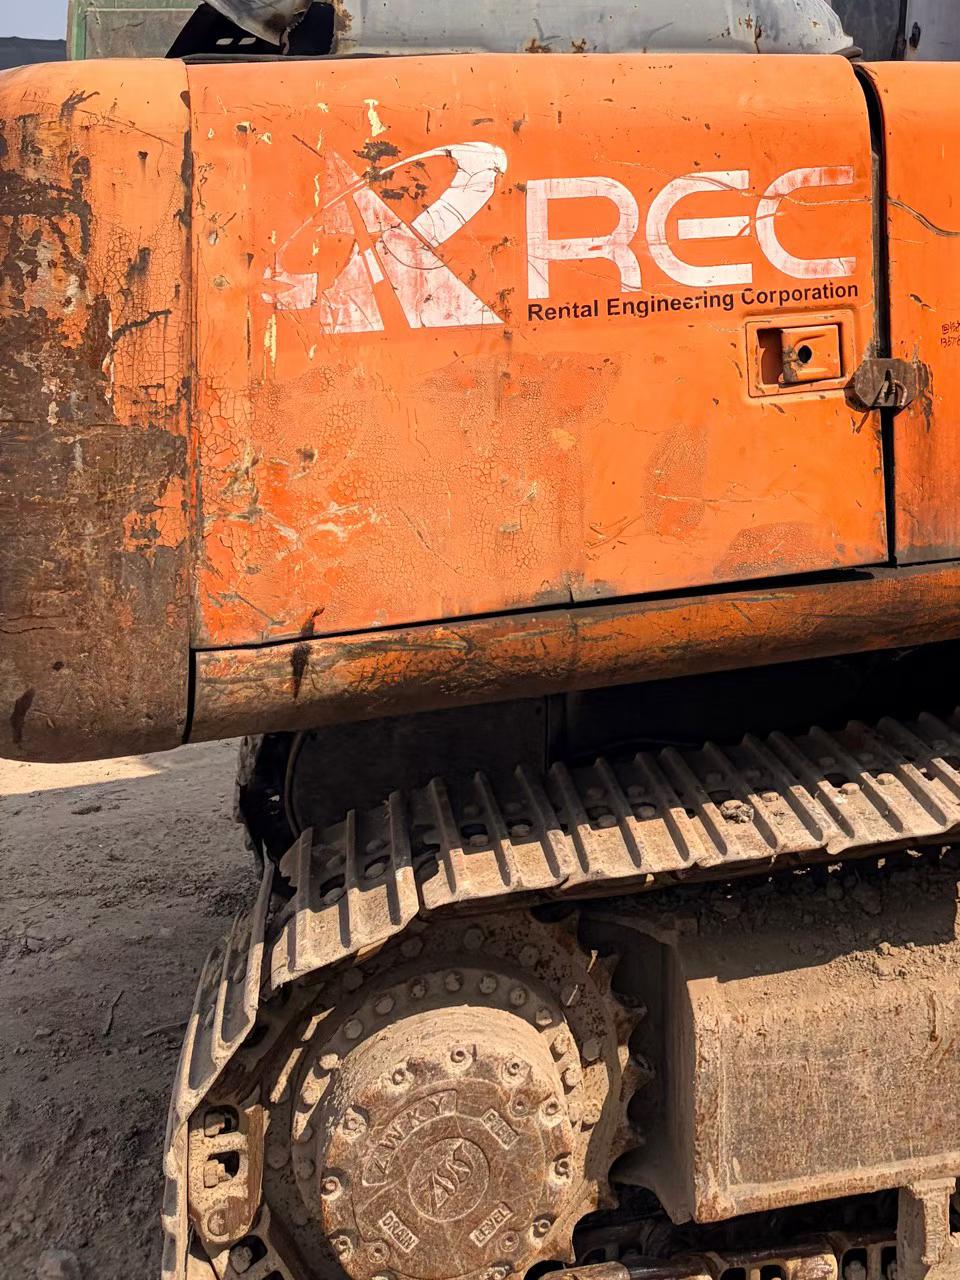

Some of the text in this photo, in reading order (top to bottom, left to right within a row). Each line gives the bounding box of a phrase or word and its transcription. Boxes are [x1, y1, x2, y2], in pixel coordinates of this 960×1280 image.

[526, 166, 856, 300] REC
[528, 282, 858, 322] Rental Engineering Corporation
[381, 1214, 416, 1252] DRAIN
